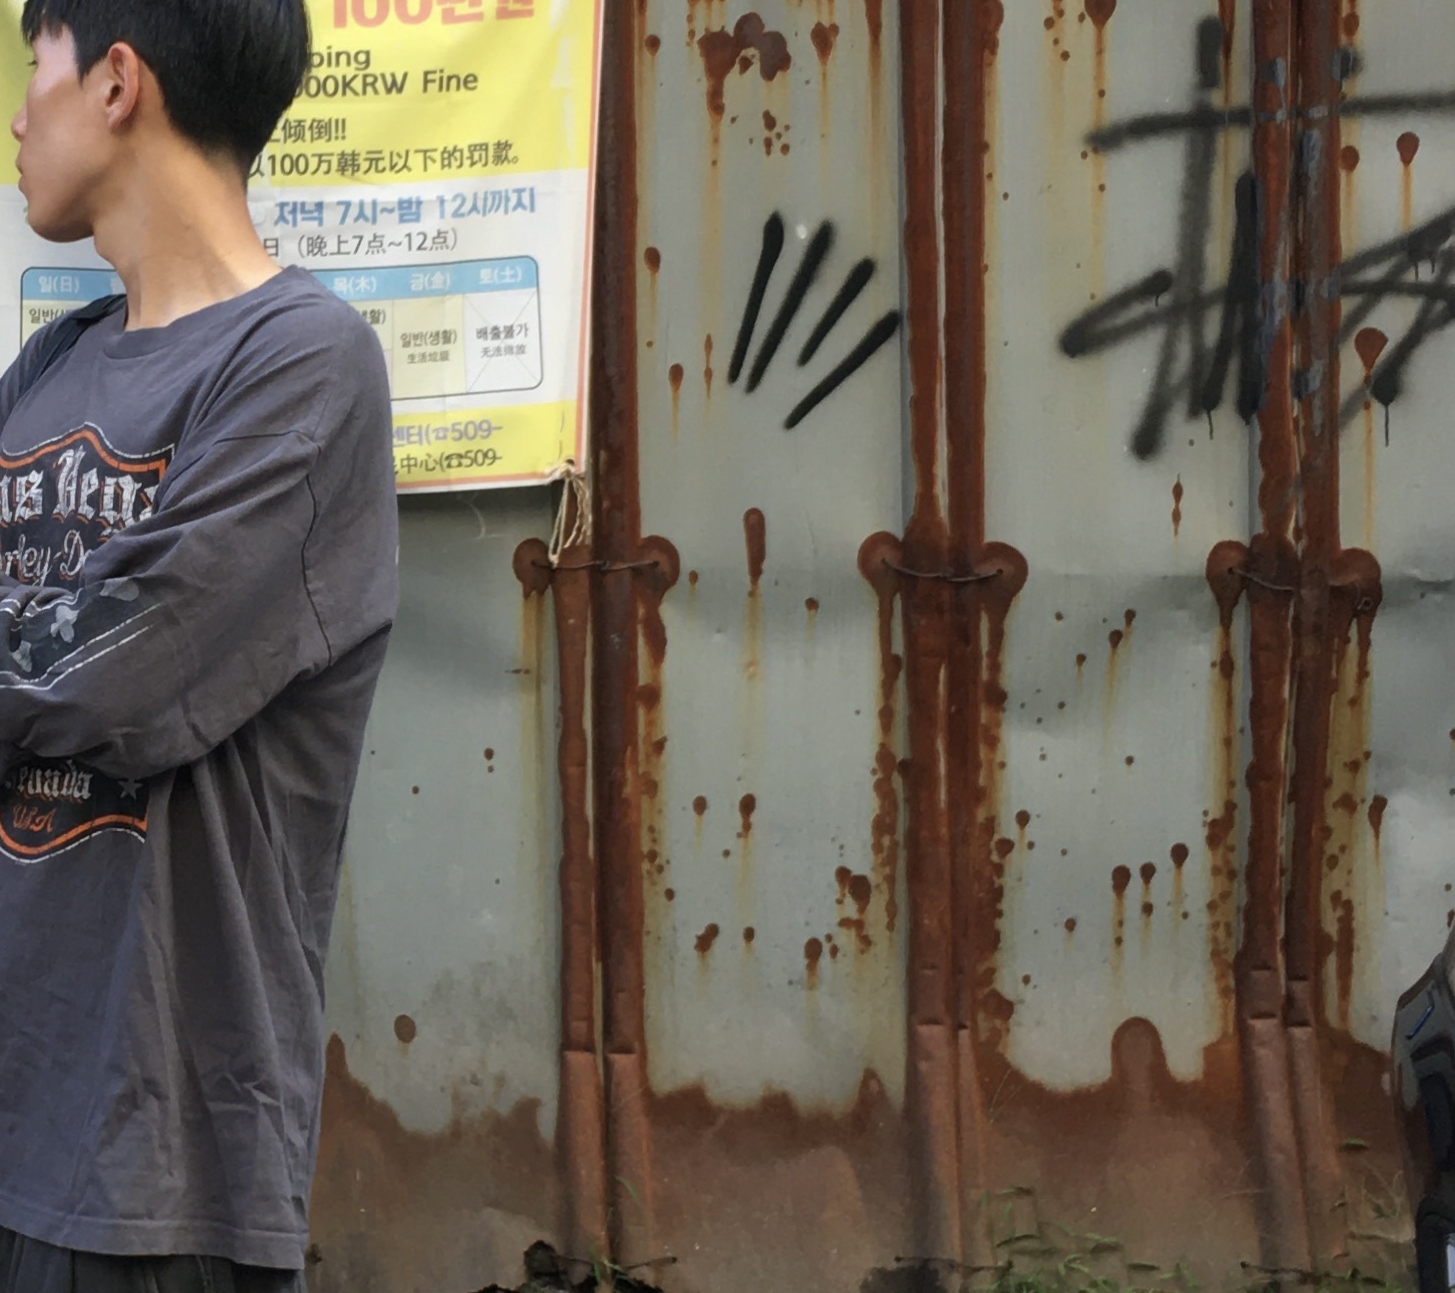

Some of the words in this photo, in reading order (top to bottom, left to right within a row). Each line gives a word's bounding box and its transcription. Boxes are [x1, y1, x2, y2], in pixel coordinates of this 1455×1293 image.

[308, 46, 372, 72] ping
[296, 71, 408, 98] 00KRW
[422, 68, 479, 94] Fine
[274, 199, 325, 228] 저녁
